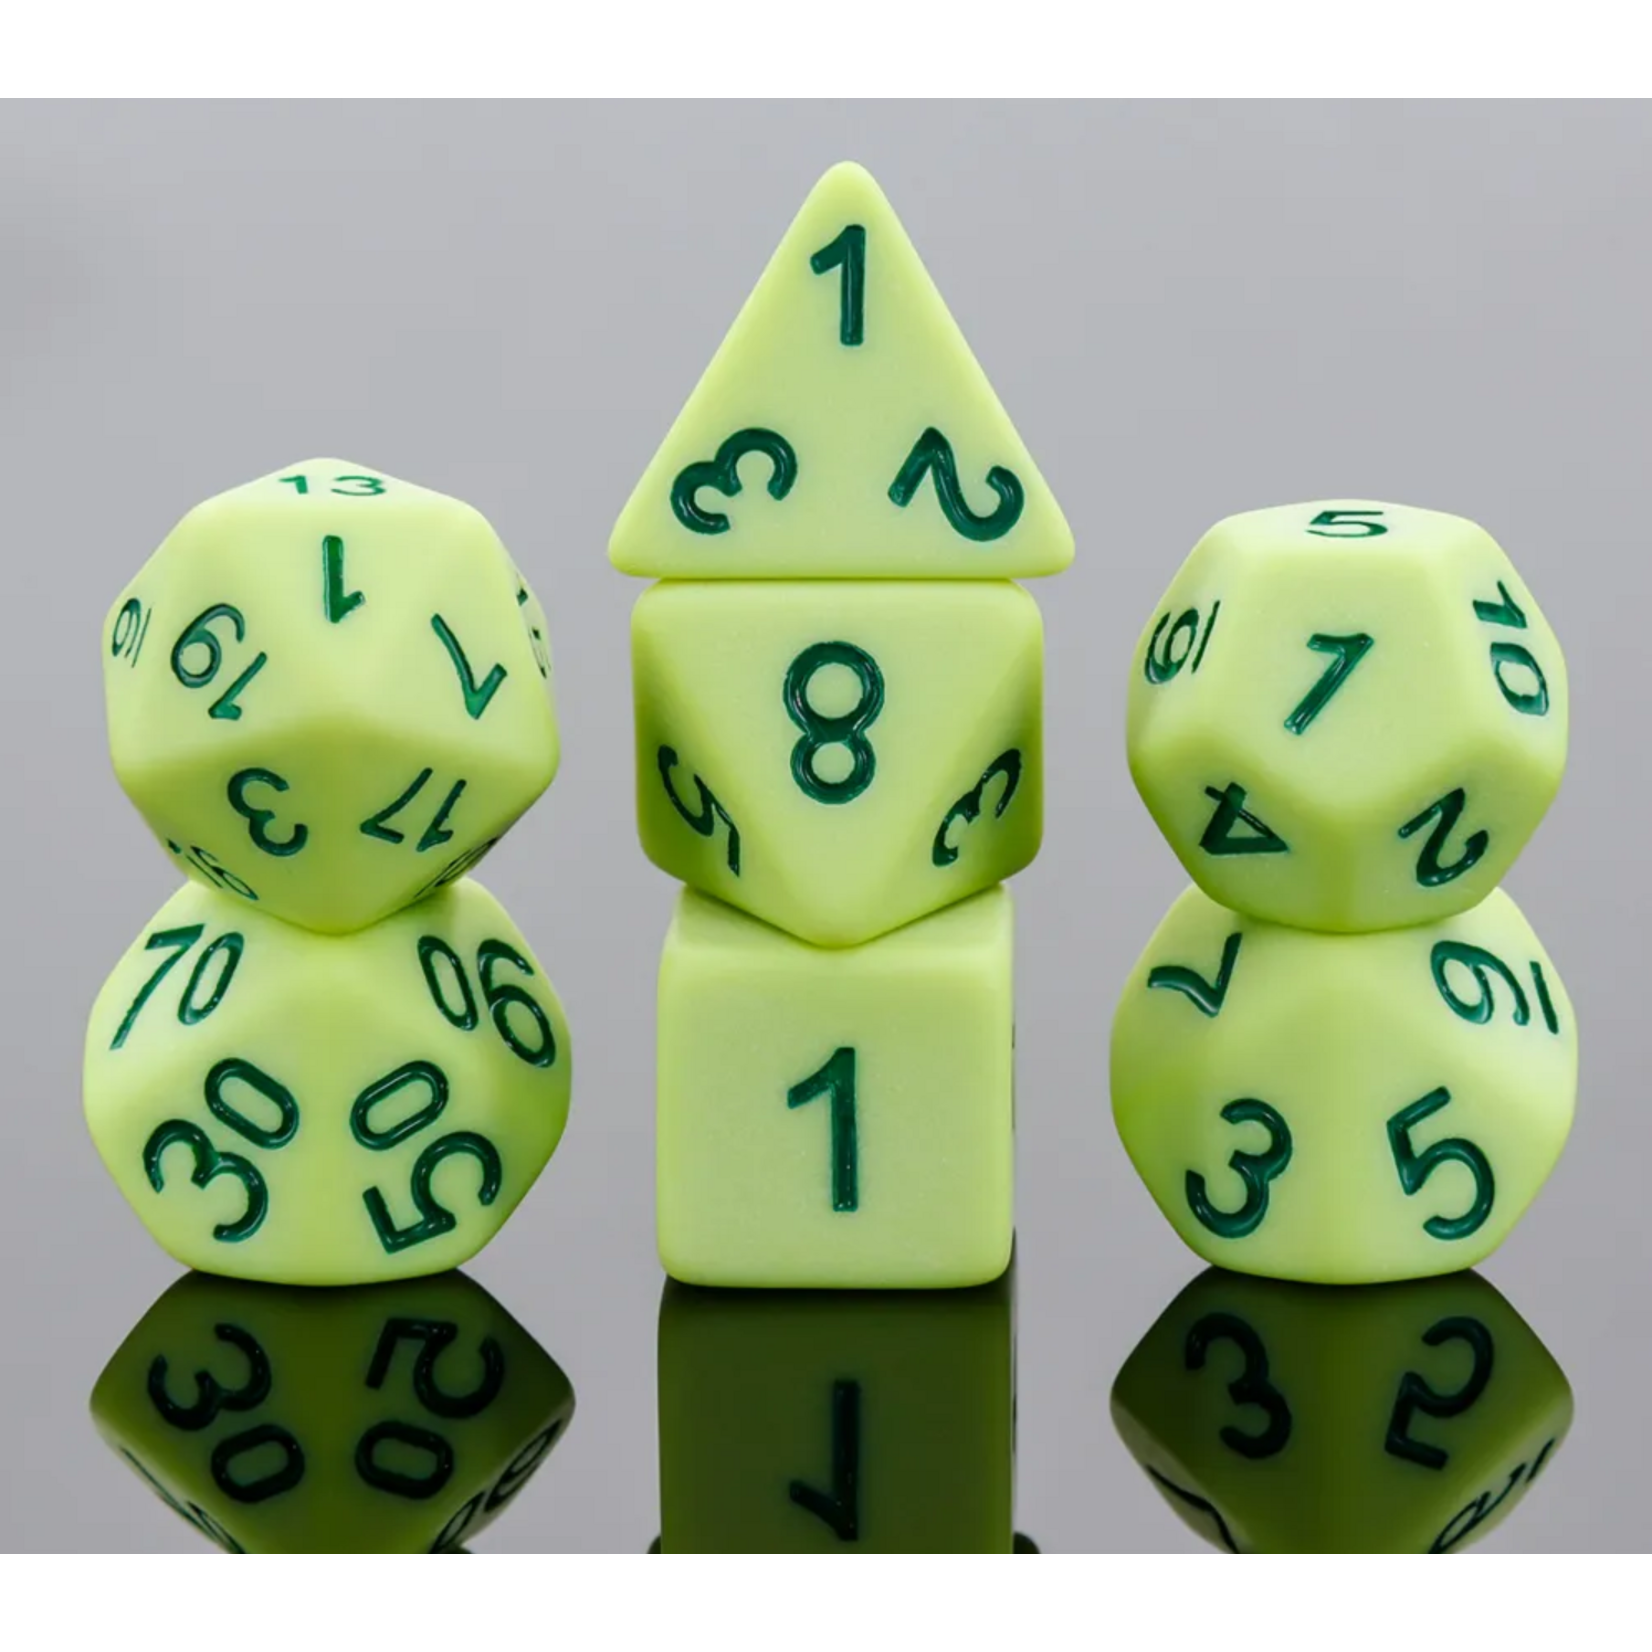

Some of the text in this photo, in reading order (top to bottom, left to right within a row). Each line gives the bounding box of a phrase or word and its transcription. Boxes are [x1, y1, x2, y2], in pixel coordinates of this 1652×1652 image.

[809, 223, 866, 347] 1
[279, 474, 387, 497] 13
[669, 427, 798, 536] 3
[887, 426, 1025, 543] 2
[1306, 510, 1389, 538] 5
[321, 535, 365, 624] 1
[171, 603, 268, 722] 19
[1283, 632, 1375, 736] 1
[1472, 580, 1550, 716] 10
[782, 640, 886, 805] 8
[227, 767, 309, 857] 3
[359, 768, 467, 853] 17
[657, 745, 740, 877] 5
[931, 748, 1022, 867] 3
[1199, 782, 1291, 857] 4
[1397, 788, 1490, 888] 2
[110, 923, 245, 1050] 70
[417, 934, 556, 1069] 90
[1147, 931, 1242, 1018] 7
[1430, 940, 1559, 1036] 9
[143, 1057, 300, 1243] 30
[349, 1059, 504, 1255] 50
[786, 1045, 861, 1213] 1
[1185, 1096, 1294, 1240] 3
[1386, 1085, 1496, 1242] 5
